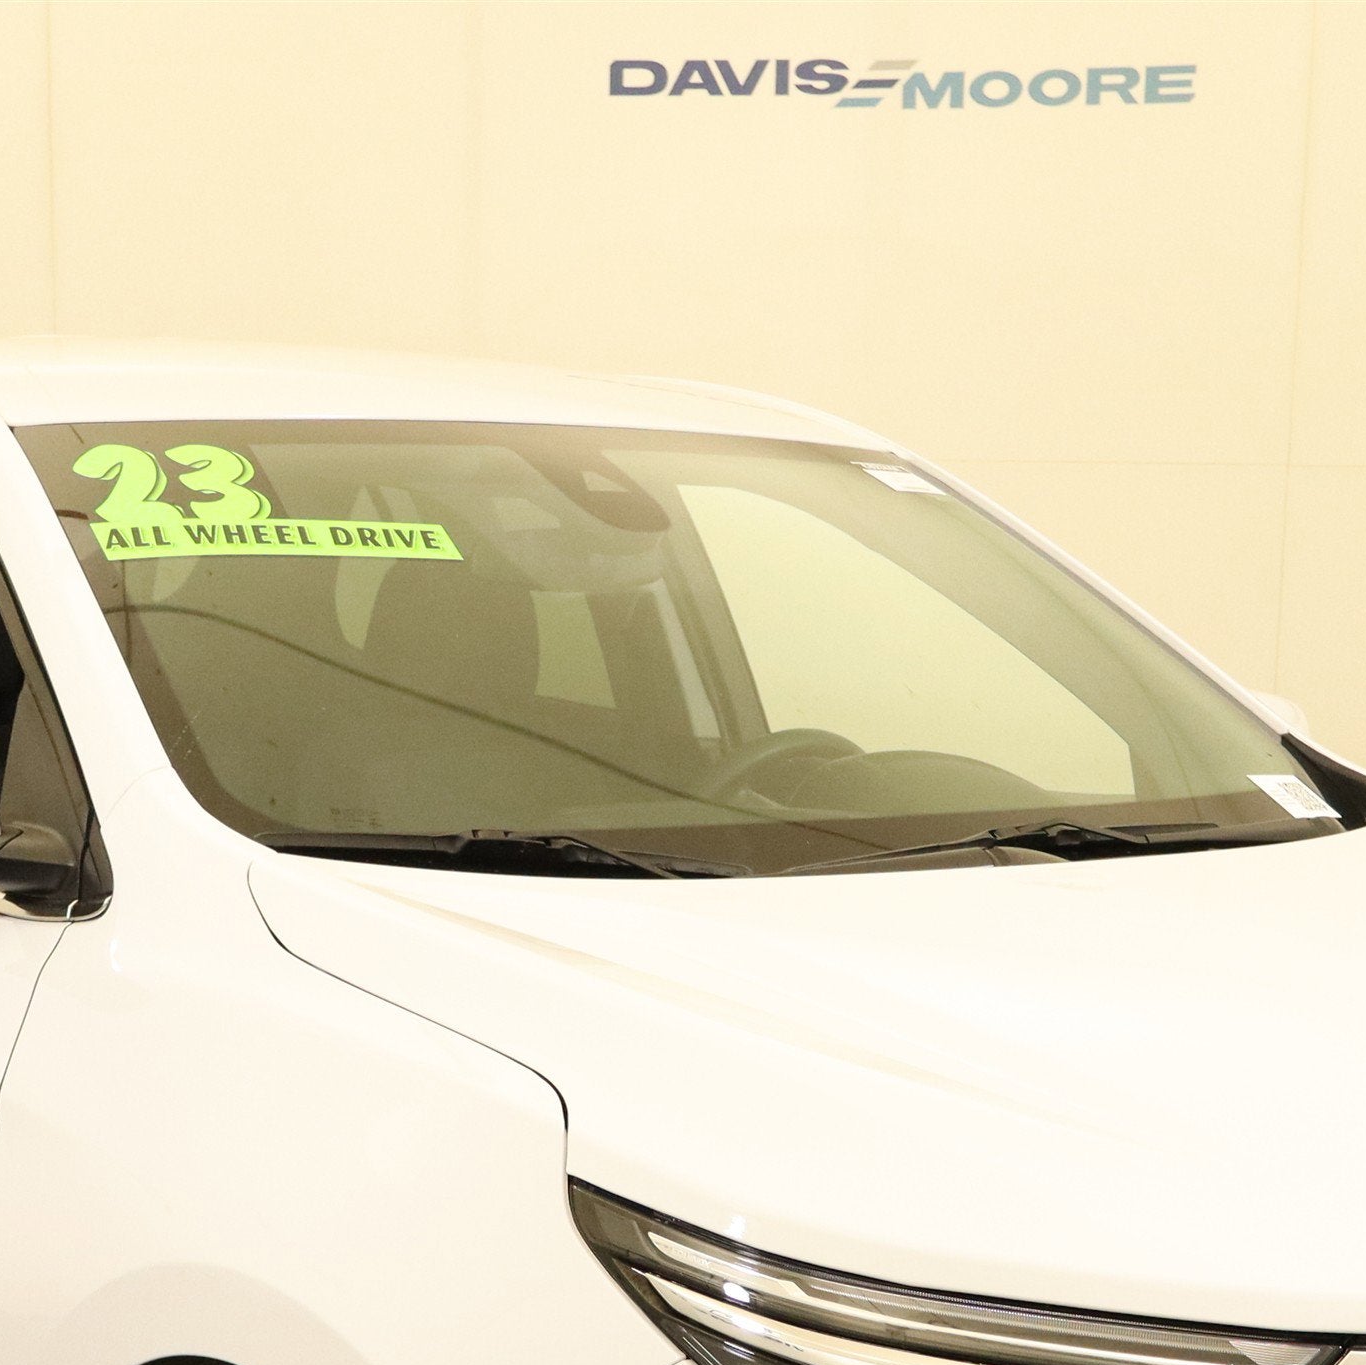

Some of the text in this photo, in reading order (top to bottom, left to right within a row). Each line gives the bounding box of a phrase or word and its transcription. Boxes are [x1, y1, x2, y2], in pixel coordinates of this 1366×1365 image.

[608, 59, 1197, 110] DAVIS MOORE
[72, 443, 273, 522] 23
[105, 523, 443, 551] ALL WHEEL DRIVE
